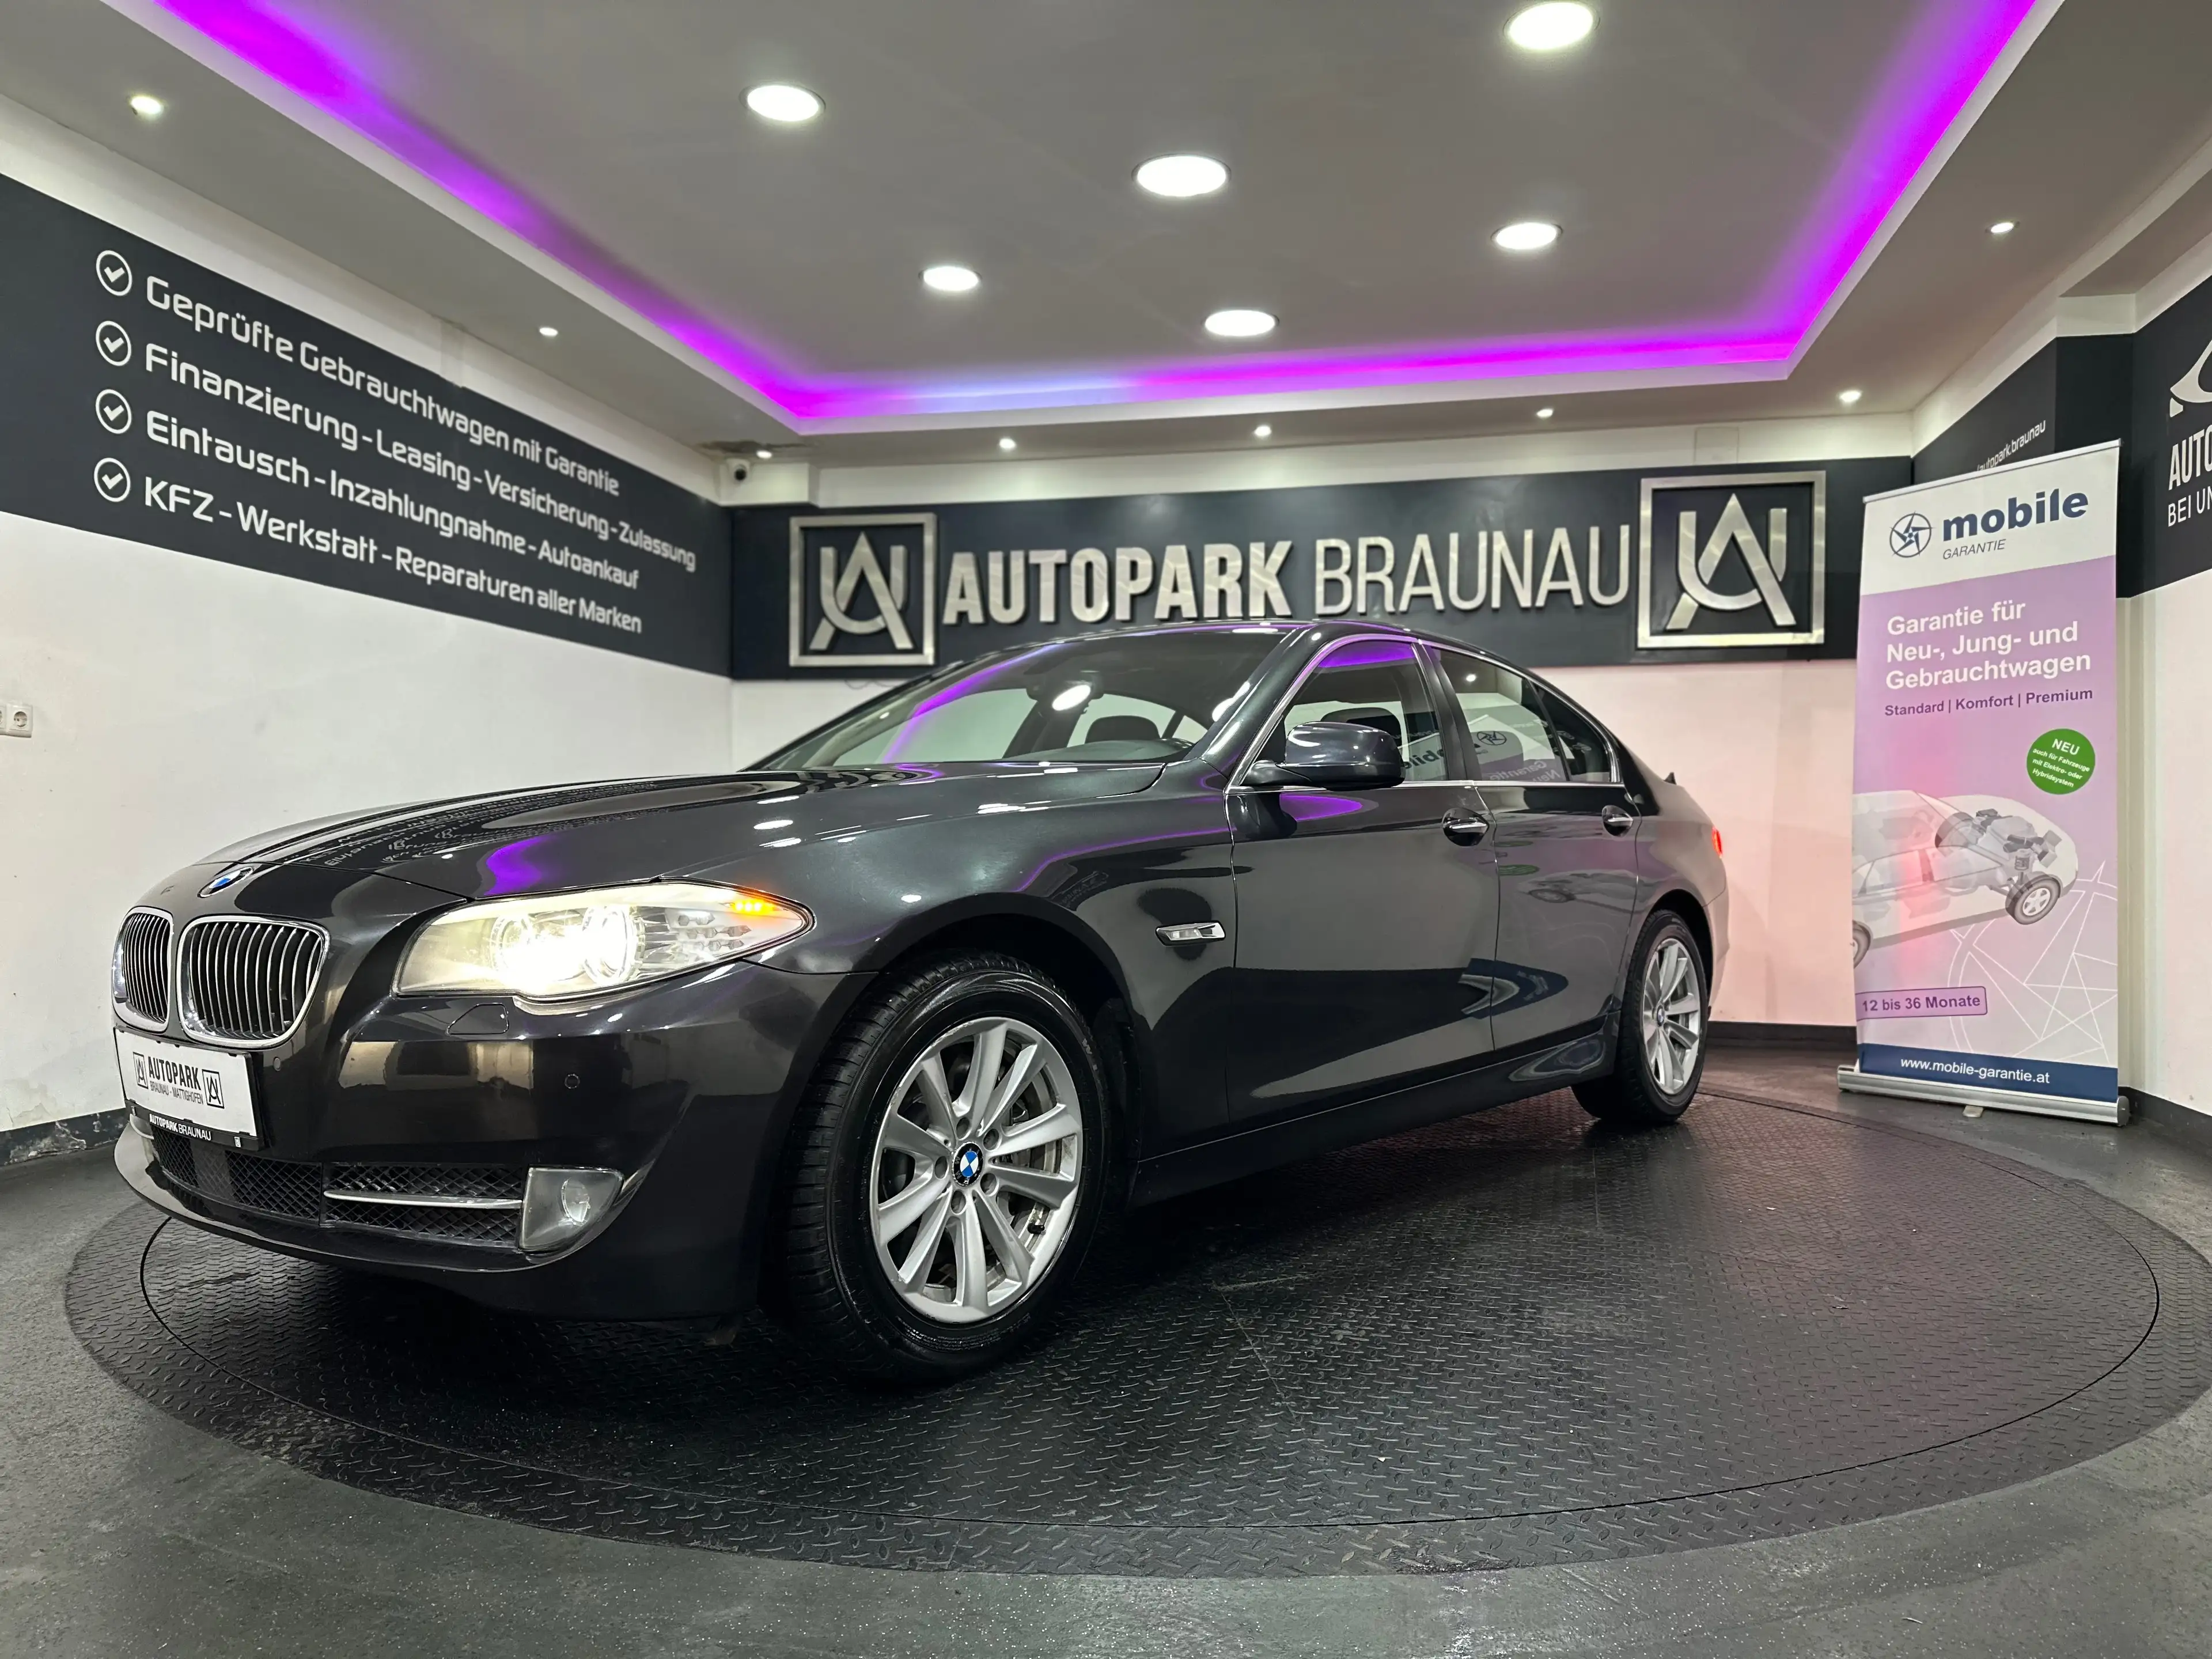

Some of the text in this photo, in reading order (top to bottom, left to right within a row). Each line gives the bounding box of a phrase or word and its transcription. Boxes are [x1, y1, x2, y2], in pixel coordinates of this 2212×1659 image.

[147, 276, 619, 496] Geprüfte Gebrauchtwagen mit Garantie
[146, 343, 357, 450] Finanzierung
[619, 521, 696, 572] Zulassung
[147, 410, 309, 487] Eintausch
[538, 540, 639, 589] Autoankauf
[1943, 488, 2089, 542] mobile
[2168, 495, 2191, 527] BEI
[145, 476, 214, 522] KFZ
[237, 502, 377, 565] Werkstatt
[396, 546, 533, 605] Reparaturen
[537, 589, 575, 616] aller
[579, 598, 642, 633] Marken
[1942, 539, 2006, 560] GARANTIE
[942, 525, 1630, 624] AUTOPARK BRAUNAU
[1888, 600, 2026, 635] Garantie für
[1887, 621, 2078, 663] Neu-, Jung- und
[1886, 654, 2091, 690] Gebrauchtwagen
[1885, 700, 1944, 716] Standard
[1956, 695, 2013, 710] Komfort
[2026, 690, 2093, 704] Premium
[2033, 748, 2048, 757] auch
[2058, 756, 2090, 772] Fahrzeuge
[2052, 738, 2080, 755] NEU
[2032, 768, 2074, 787] Hybridsystem
[2043, 762, 2067, 774] Elektro-
[2067, 771, 2083, 779] oder
[1862, 995, 1980, 1012] 12 bis 36 Monate
[148, 1056, 202, 1090] AUTOPARK
[1901, 1057, 2050, 1084] www.mobile-garantie.at
[150, 1081, 169, 1095] BRAUNAU
[172, 1087, 203, 1105] MATTIGHOFEN
[149, 1113, 211, 1141] AUTOPARK BRAUNAU
